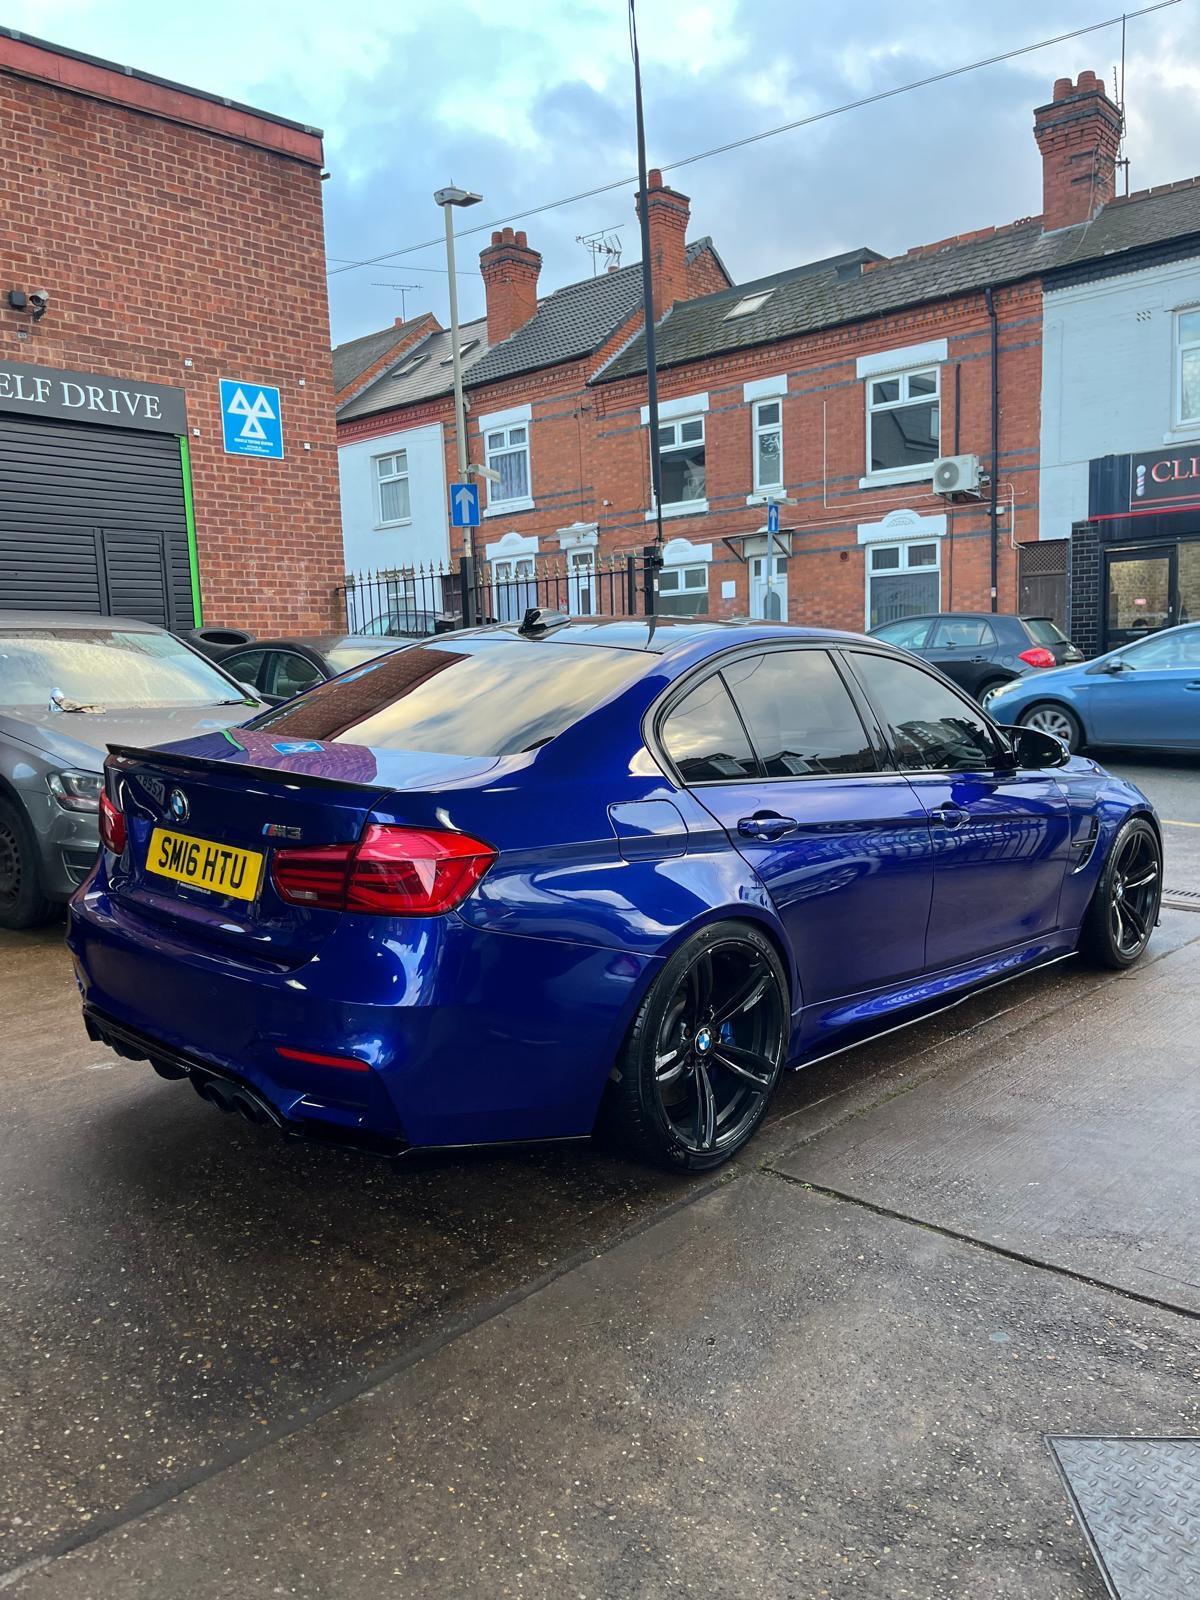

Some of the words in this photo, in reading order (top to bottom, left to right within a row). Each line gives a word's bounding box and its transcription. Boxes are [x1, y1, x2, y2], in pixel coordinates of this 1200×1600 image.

[59, 381, 162, 420] DRIVE
[266, 823, 302, 840] M3
[158, 836, 200, 877] SM16
[201, 847, 248, 890] HTU
